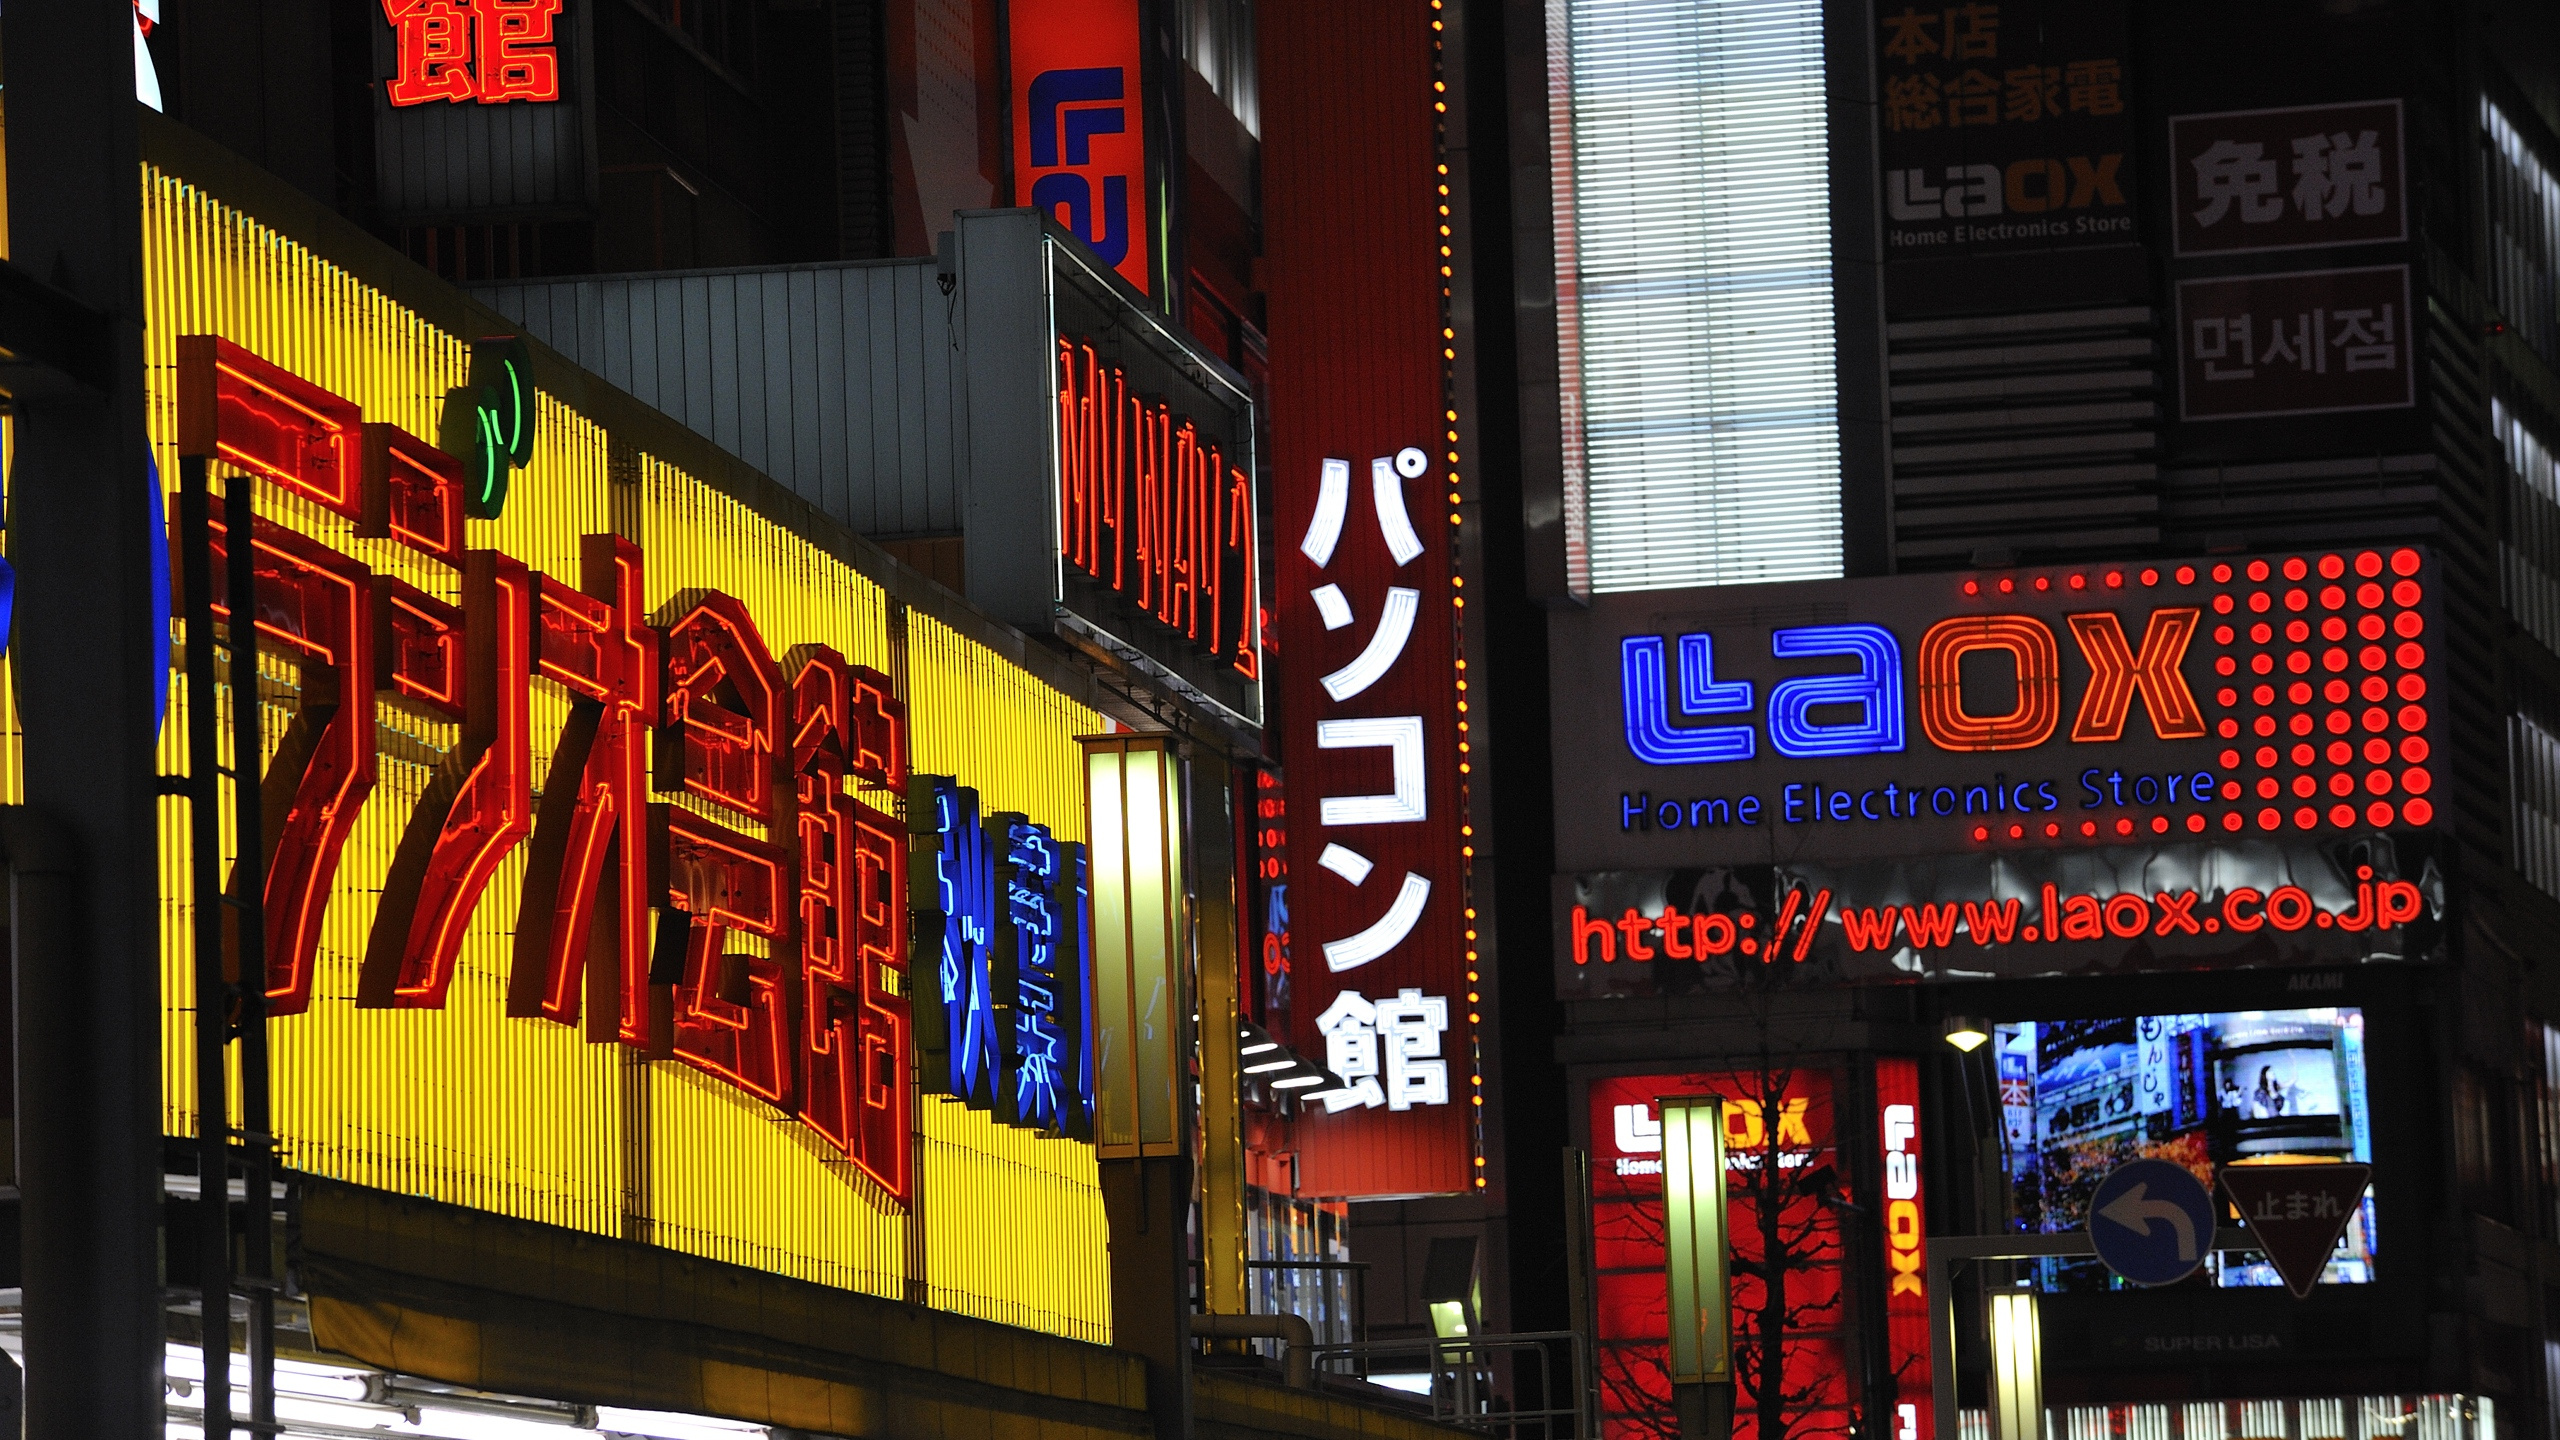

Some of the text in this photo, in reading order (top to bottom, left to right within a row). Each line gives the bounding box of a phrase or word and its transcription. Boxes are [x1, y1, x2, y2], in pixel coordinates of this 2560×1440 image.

[1882, 2, 1998, 65] 本店
[1883, 58, 2125, 132] 総合家電
[2191, 130, 2387, 228] 免税
[1889, 214, 2132, 248] Home Electronics Store
[2193, 303, 2397, 381] 면세점
[1301, 446, 1449, 1113] パソコン館
[1622, 768, 2215, 831] Home Electronics Store
[2253, 1190, 2343, 1222] 止まれ
[2143, 1333, 2282, 1352] SUPER LISA
